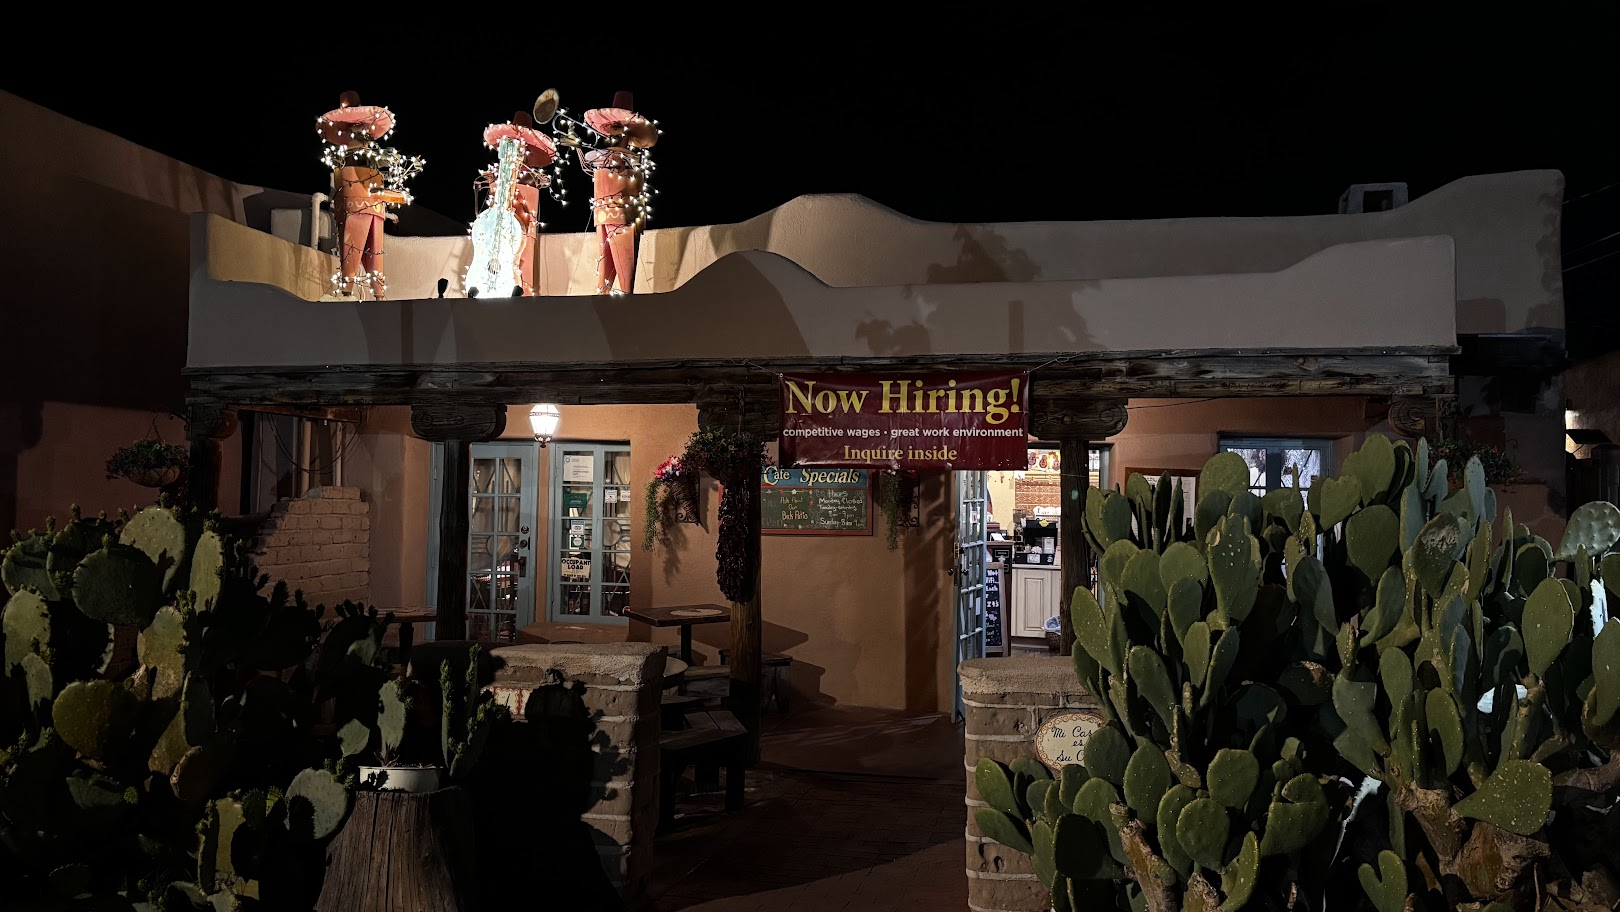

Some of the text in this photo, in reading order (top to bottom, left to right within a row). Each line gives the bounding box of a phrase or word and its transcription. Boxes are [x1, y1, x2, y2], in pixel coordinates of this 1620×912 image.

[785, 378, 1020, 425] Now Hiring!
[783, 427, 1024, 438] competitive wages great work environment
[844, 445, 957, 464] Inquire inside
[800, 468, 860, 486] Specials
[1051, 725, 1093, 738] Mi Cas
[1071, 739, 1085, 747] es
[1056, 750, 1072, 762] Su
